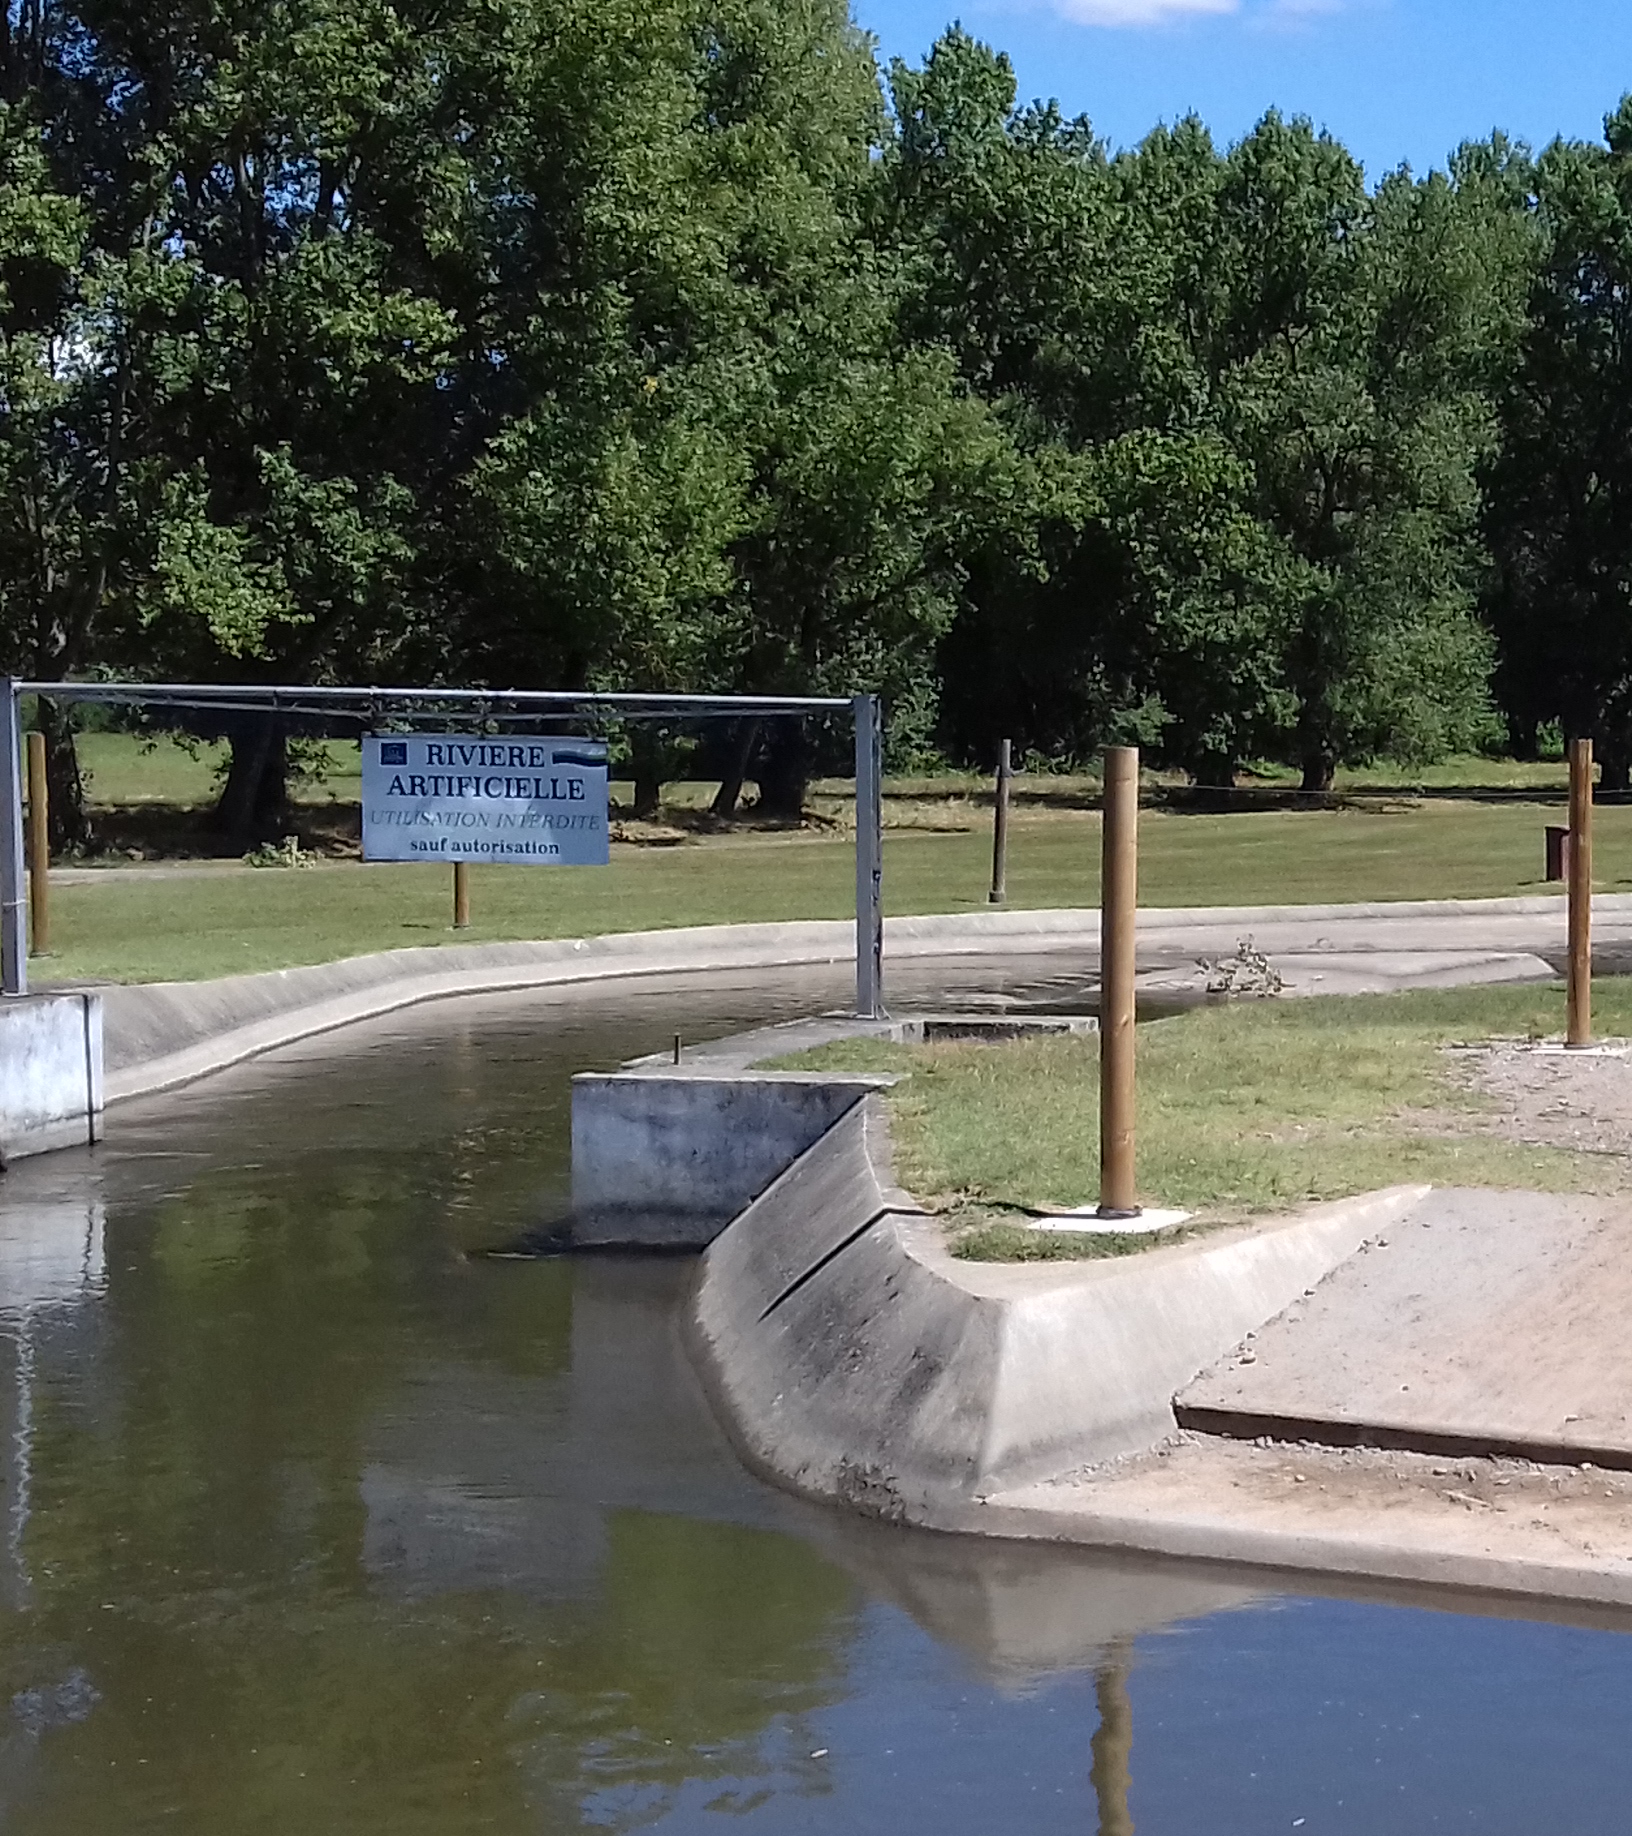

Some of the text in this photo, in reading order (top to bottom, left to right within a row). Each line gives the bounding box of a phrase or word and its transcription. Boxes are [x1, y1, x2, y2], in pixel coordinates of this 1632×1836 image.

[427, 744, 545, 768] RIVIERE
[387, 775, 585, 800] ARTIFICIELLE
[370, 810, 600, 831] UTILISATION INTERDITE
[410, 838, 559, 855] sauf autorisation
